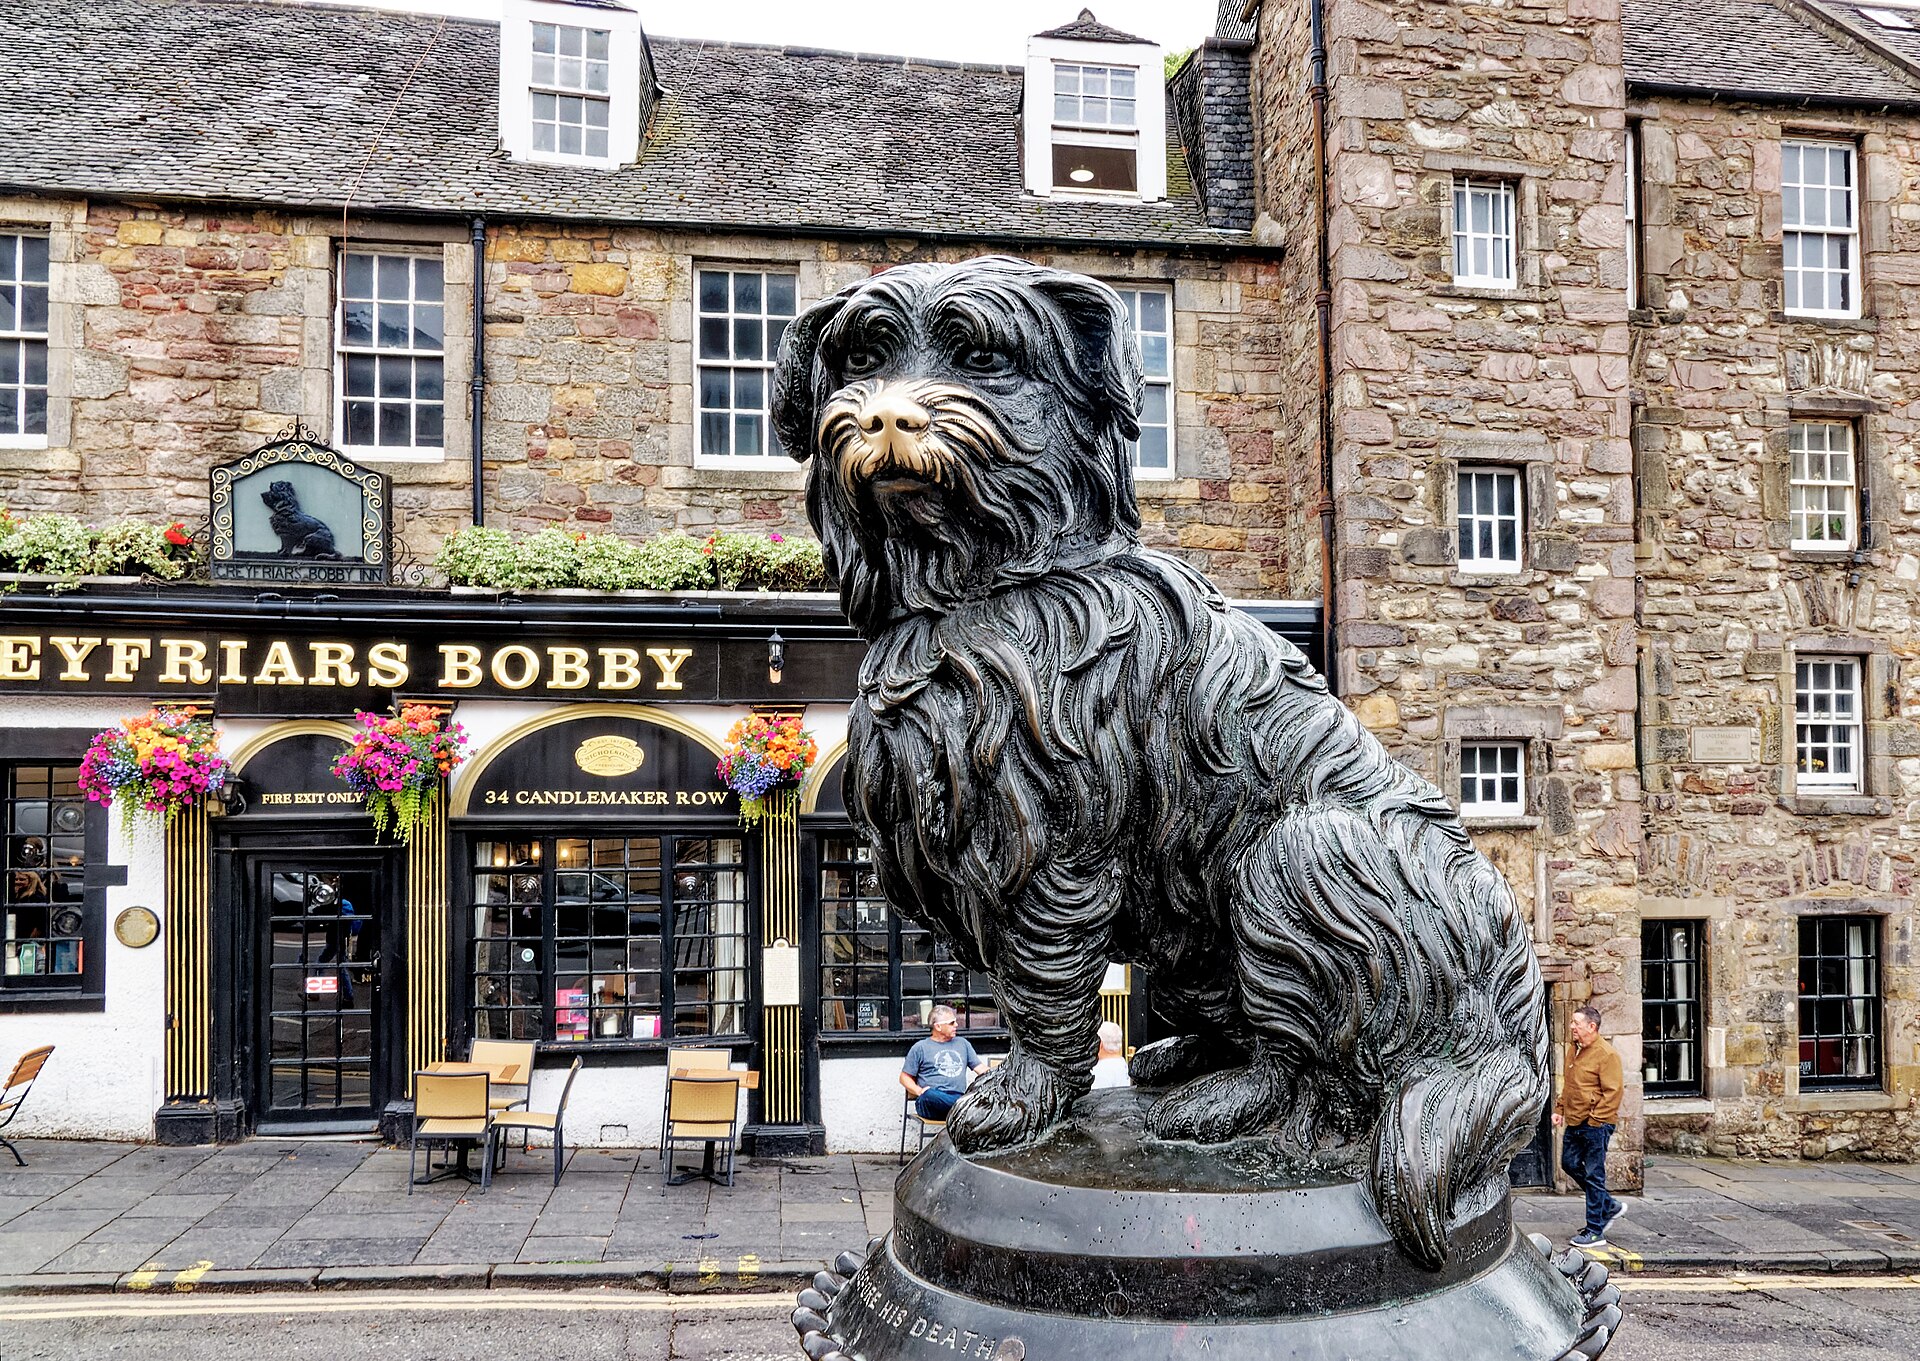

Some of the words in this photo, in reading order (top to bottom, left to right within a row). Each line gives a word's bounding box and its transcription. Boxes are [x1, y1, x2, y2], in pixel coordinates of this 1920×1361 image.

[308, 567, 352, 582] BOBBY
[359, 568, 382, 582] INN
[0, 635, 409, 688] EYFRIARS
[438, 644, 693, 690] BOBBY
[262, 793, 292, 805] FIRE
[294, 792, 325, 804] EXIT
[327, 792, 364, 803] ONLY
[485, 790, 509, 804] 34
[515, 790, 669, 805] CANDLEMAKER
[675, 791, 728, 805] ROW
[878, 1299, 908, 1328] HIS
[909, 1315, 997, 1360] DEATH
